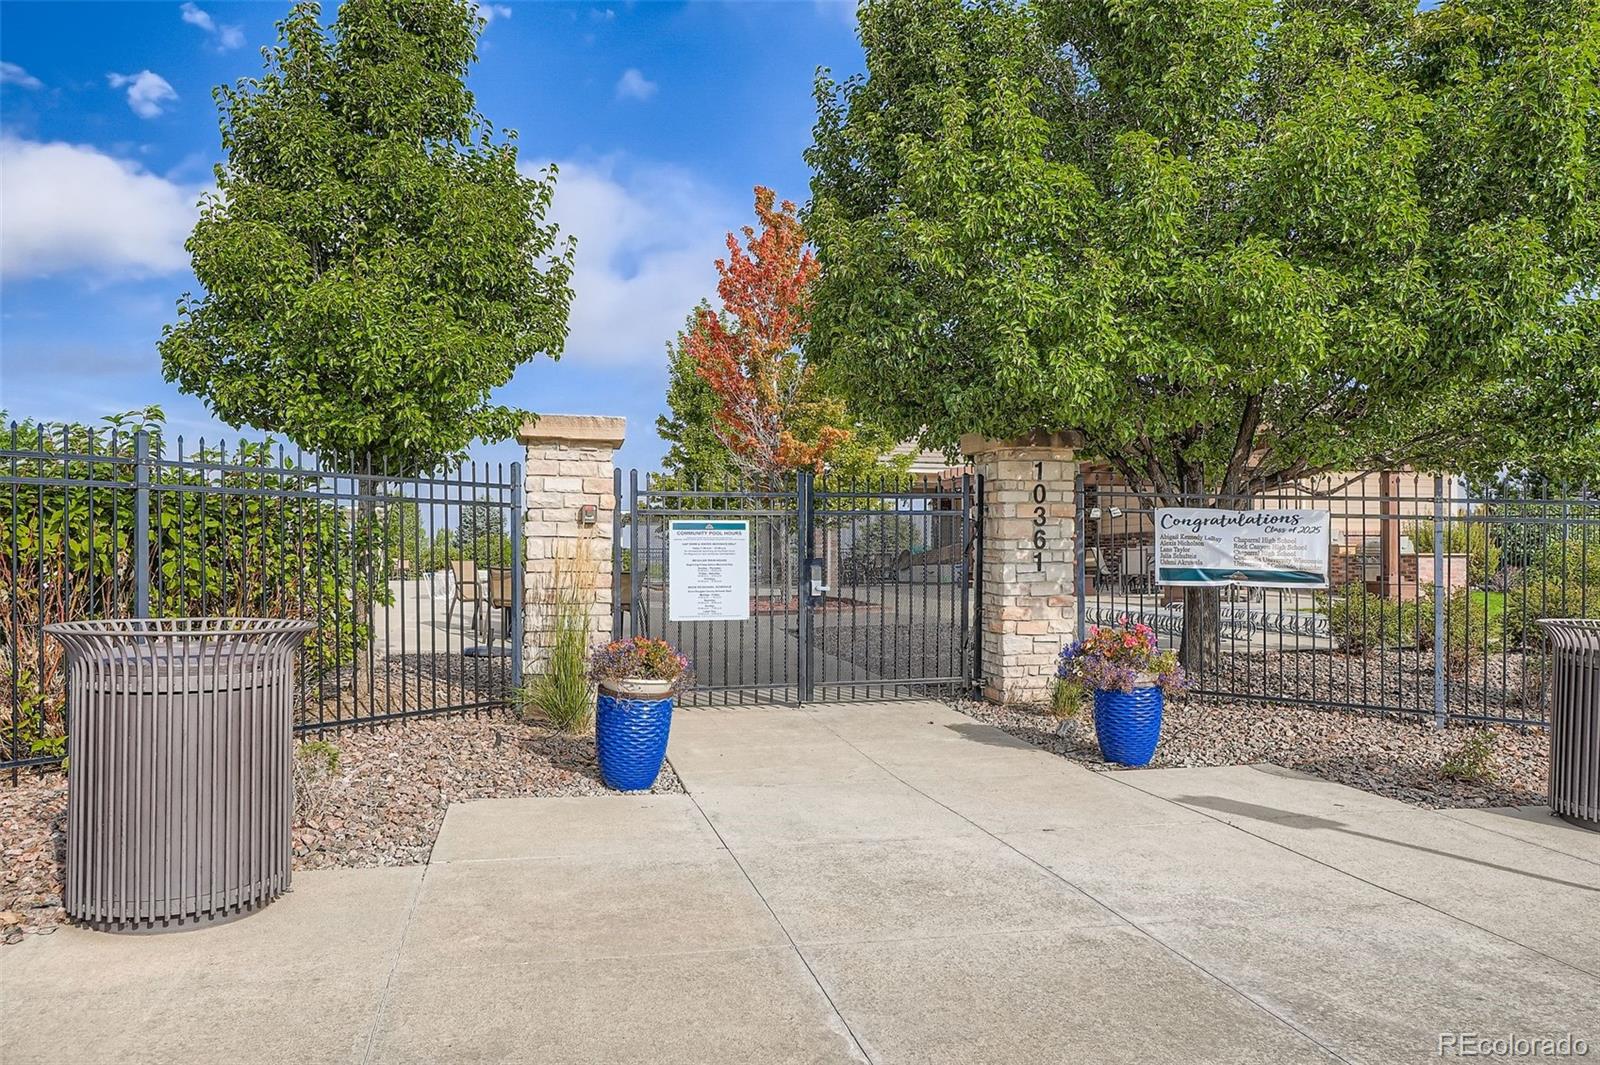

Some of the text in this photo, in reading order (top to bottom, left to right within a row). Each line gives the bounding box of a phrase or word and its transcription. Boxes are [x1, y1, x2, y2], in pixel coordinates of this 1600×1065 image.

[1033, 462, 1046, 572] 10361
[1161, 513, 1302, 533] Congratulations
[1264, 525, 1321, 534] Class of 2025
[1262, 536, 1276, 545] High
[1272, 544, 1286, 552] High
